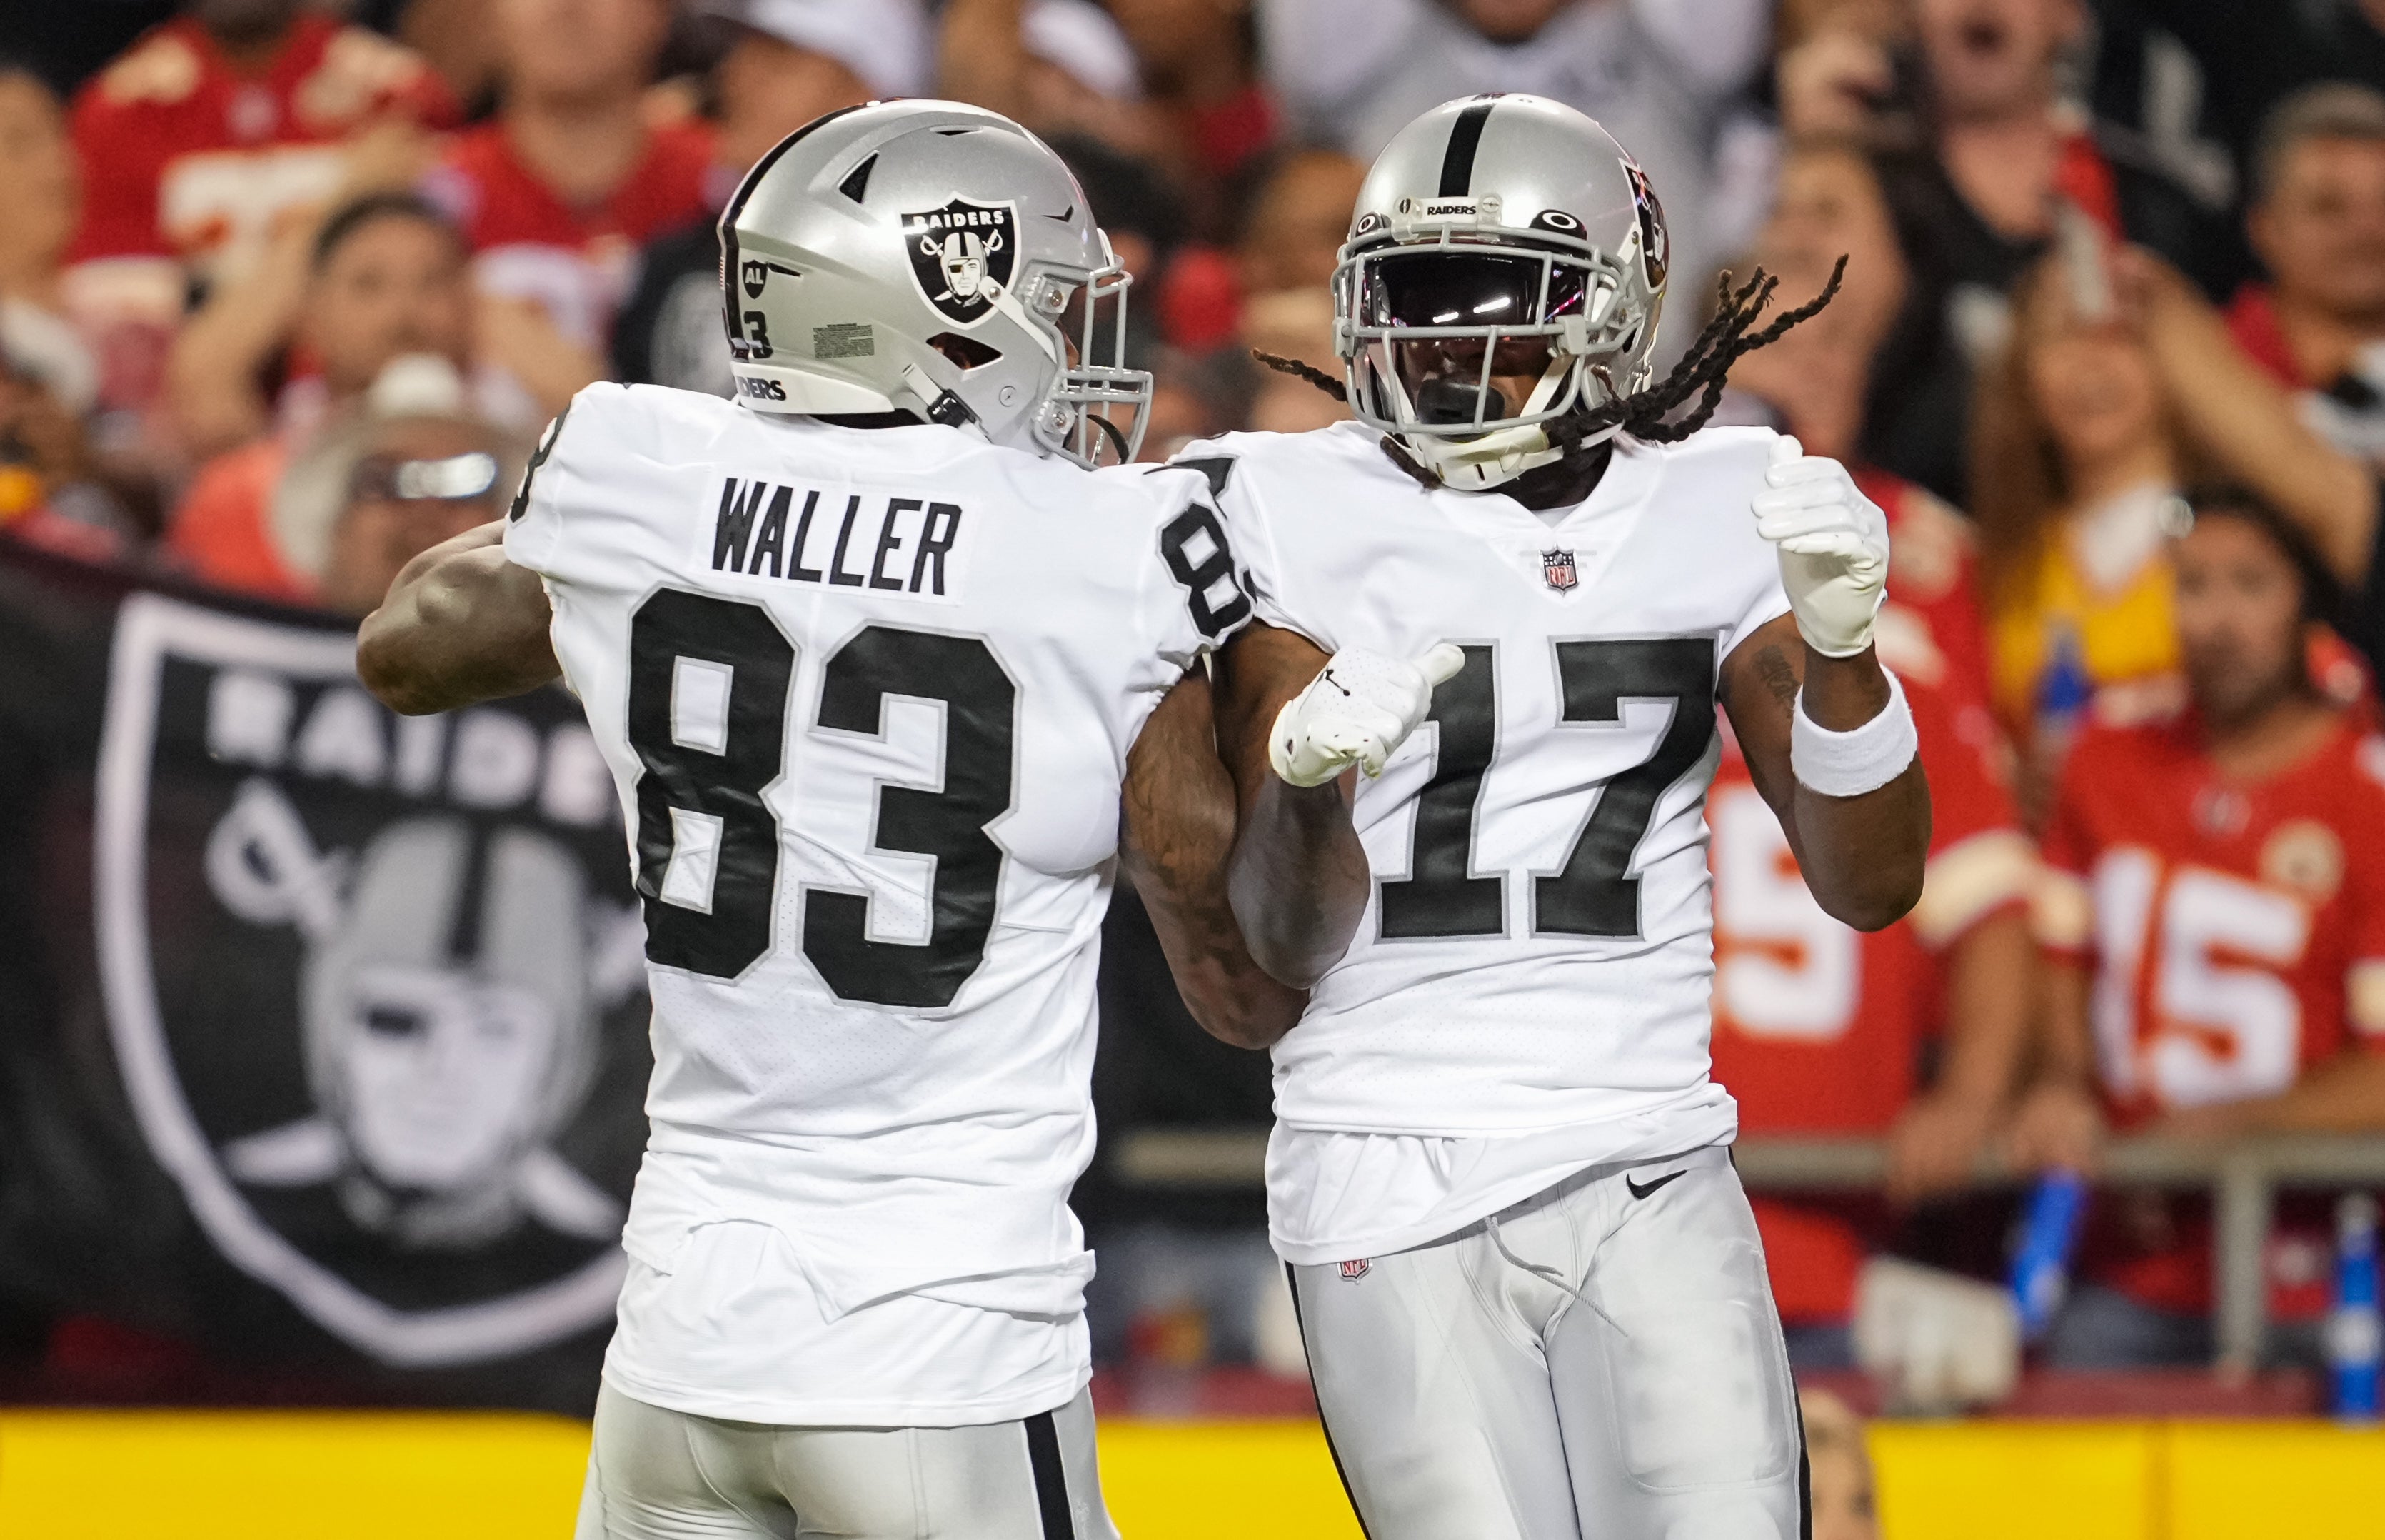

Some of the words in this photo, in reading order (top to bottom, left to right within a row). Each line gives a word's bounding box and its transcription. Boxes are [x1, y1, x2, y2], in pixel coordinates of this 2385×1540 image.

[913, 210, 1005, 229] RAIDERS
[1428, 205, 1477, 216] RAIDERS
[744, 267, 764, 285] AL
[711, 477, 963, 596] WALLER
[1547, 565, 1575, 586] NFL
[626, 583, 1023, 1016] 83
[1372, 633, 1719, 943] 17
[2092, 846, 2308, 1111] 15
